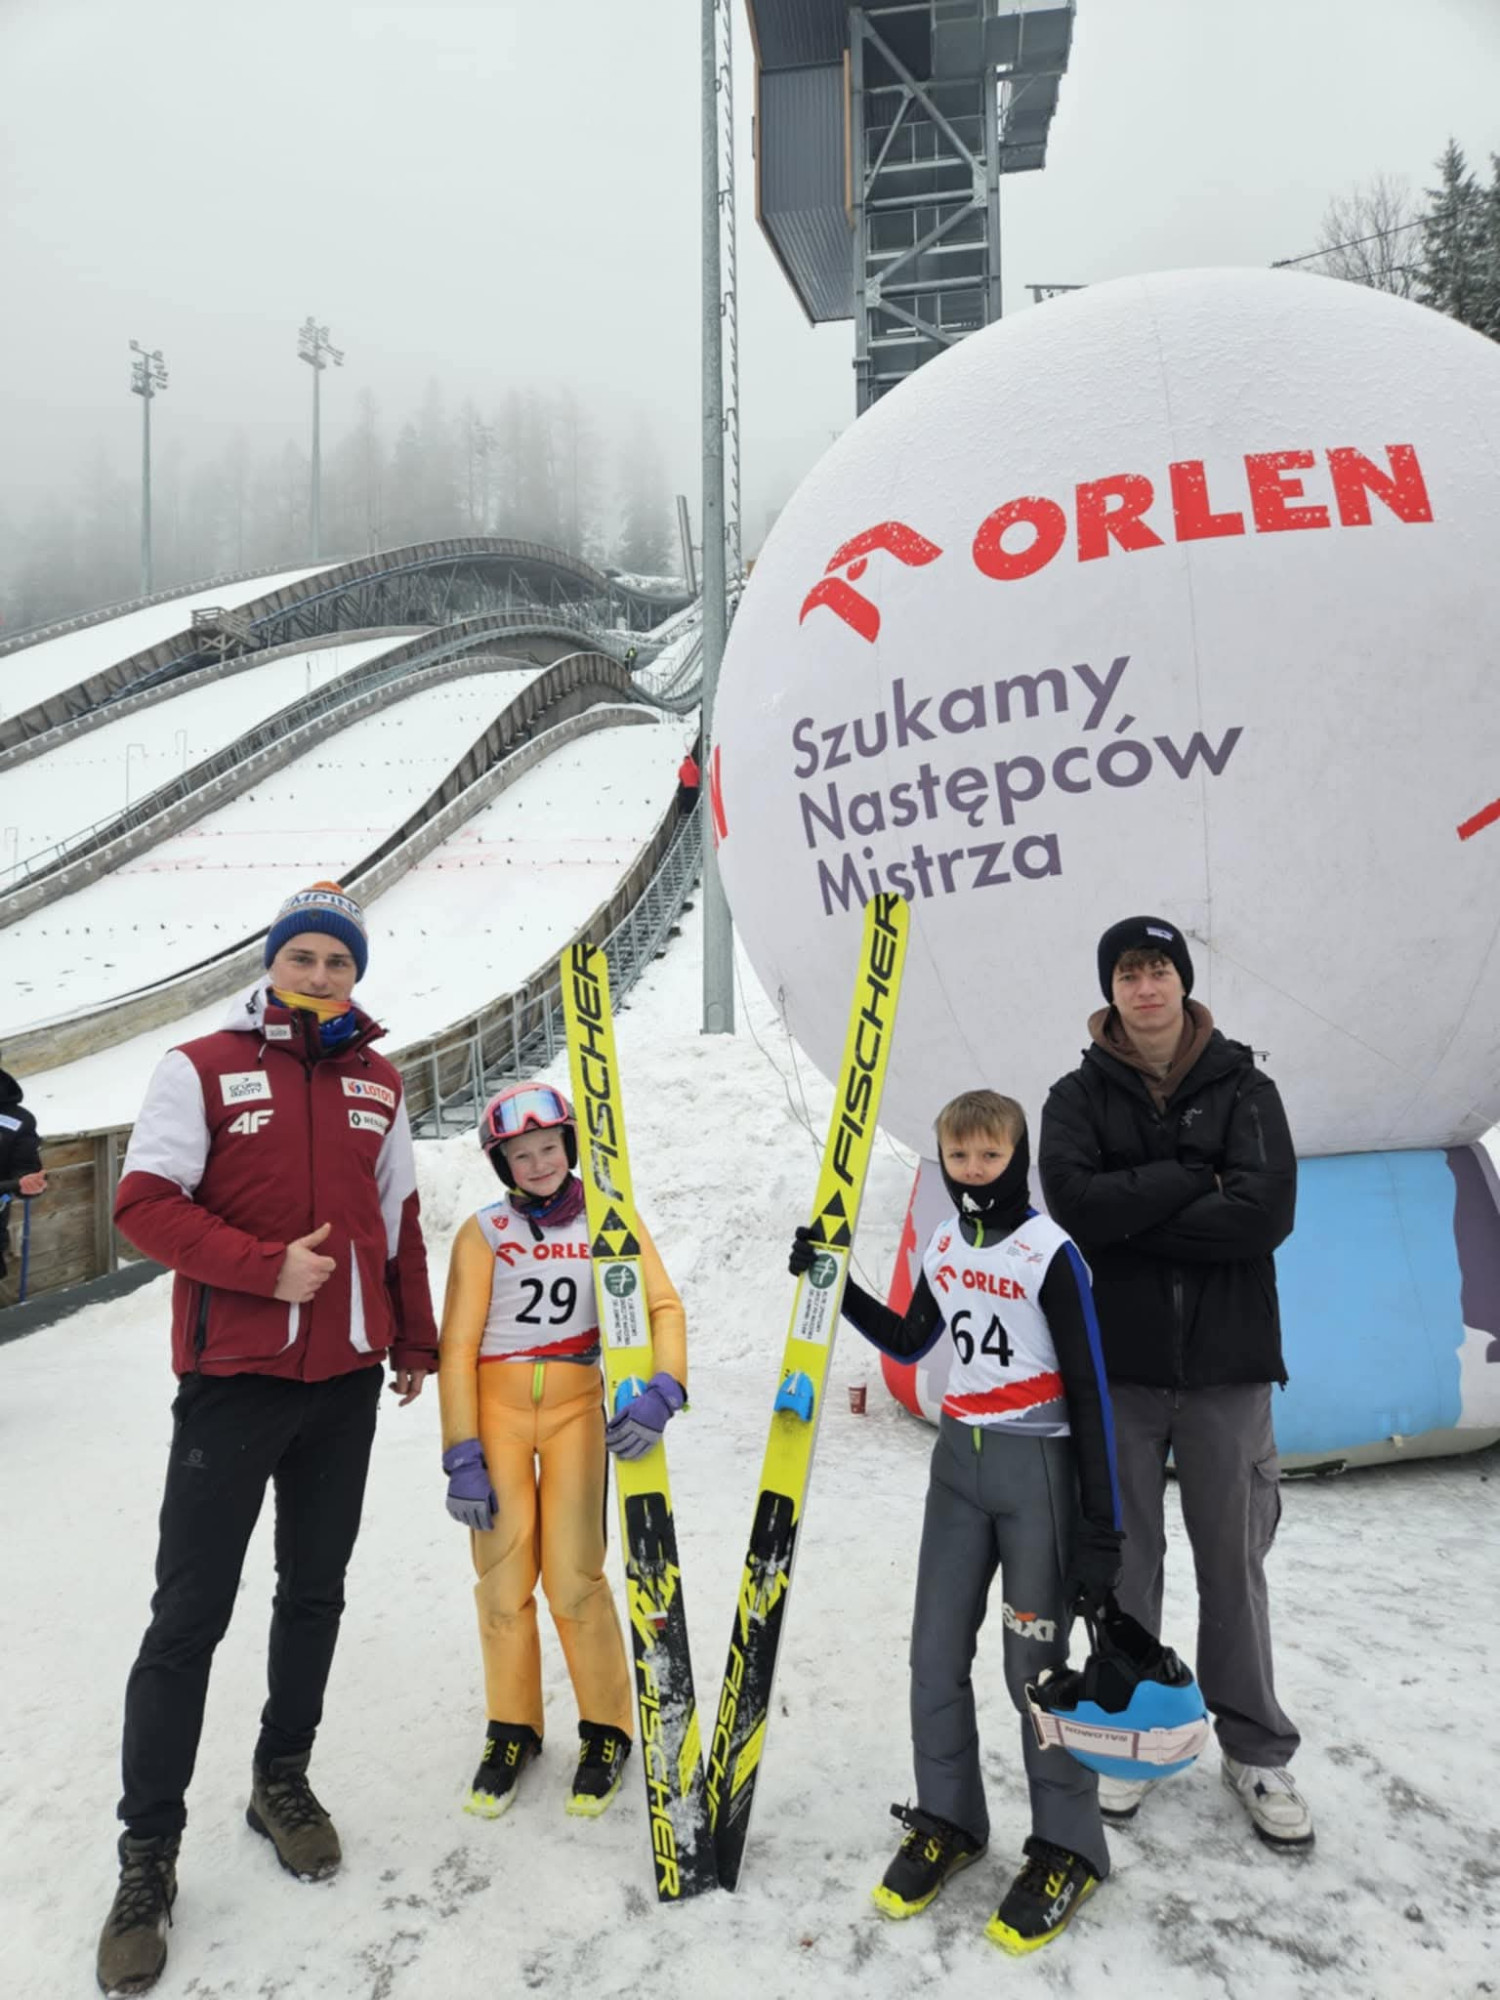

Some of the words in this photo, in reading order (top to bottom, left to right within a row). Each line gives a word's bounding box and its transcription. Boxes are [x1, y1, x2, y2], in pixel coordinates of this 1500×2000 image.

[972, 444, 1433, 581] ORLEN
[792, 656, 1131, 779] Szukamy
[799, 714, 1244, 849] Następców
[817, 833, 1064, 918] Mistrza
[571, 943, 624, 1202] FISCHER
[832, 892, 900, 1187] FISCHER
[227, 1109, 274, 1135] 4F
[515, 1277, 577, 1325] 29
[951, 1310, 1014, 1367] 64
[635, 1658, 681, 1898] FISCHER
